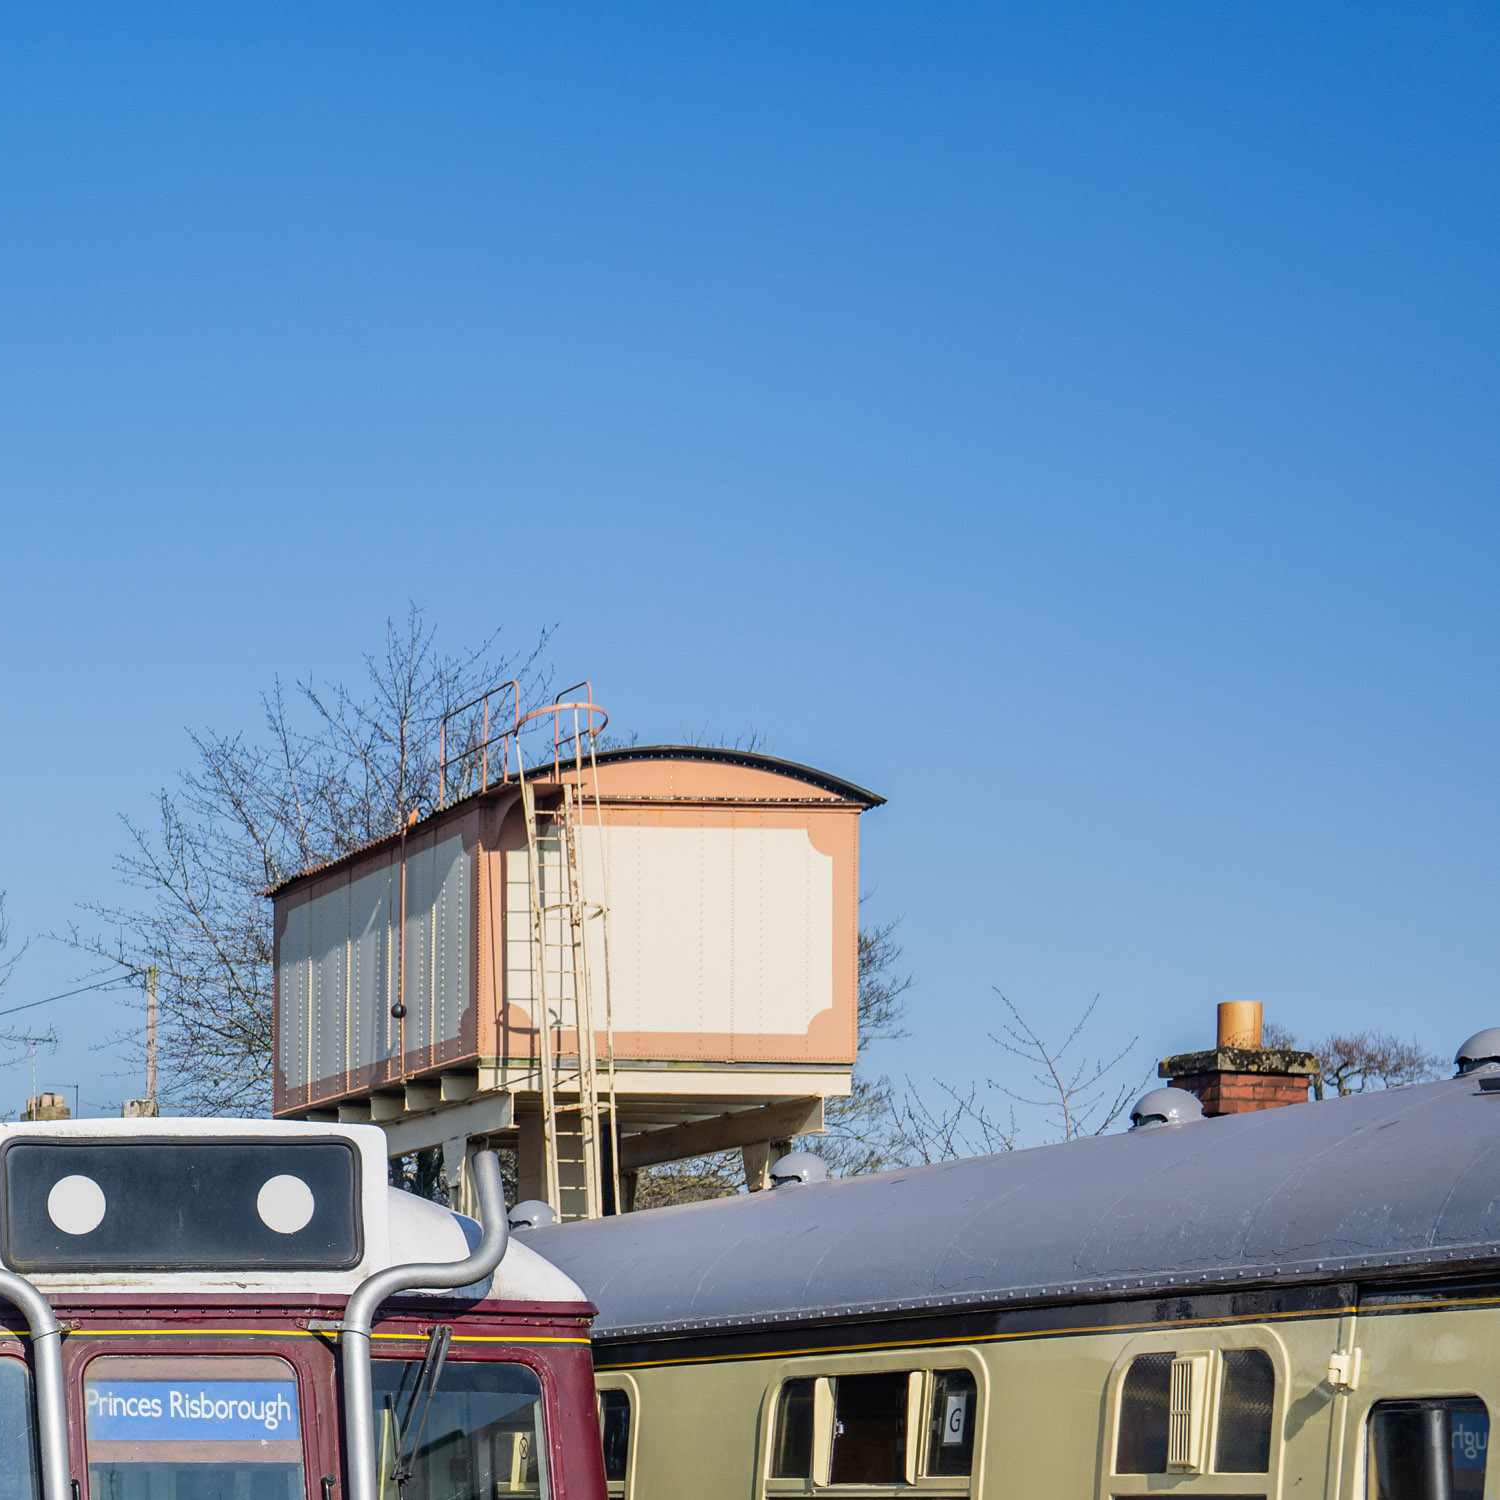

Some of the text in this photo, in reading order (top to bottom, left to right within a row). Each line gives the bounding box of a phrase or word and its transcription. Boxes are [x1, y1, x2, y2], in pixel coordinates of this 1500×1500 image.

[85, 1388, 291, 1430] Princes Risborough
[950, 1407, 962, 1433] G
